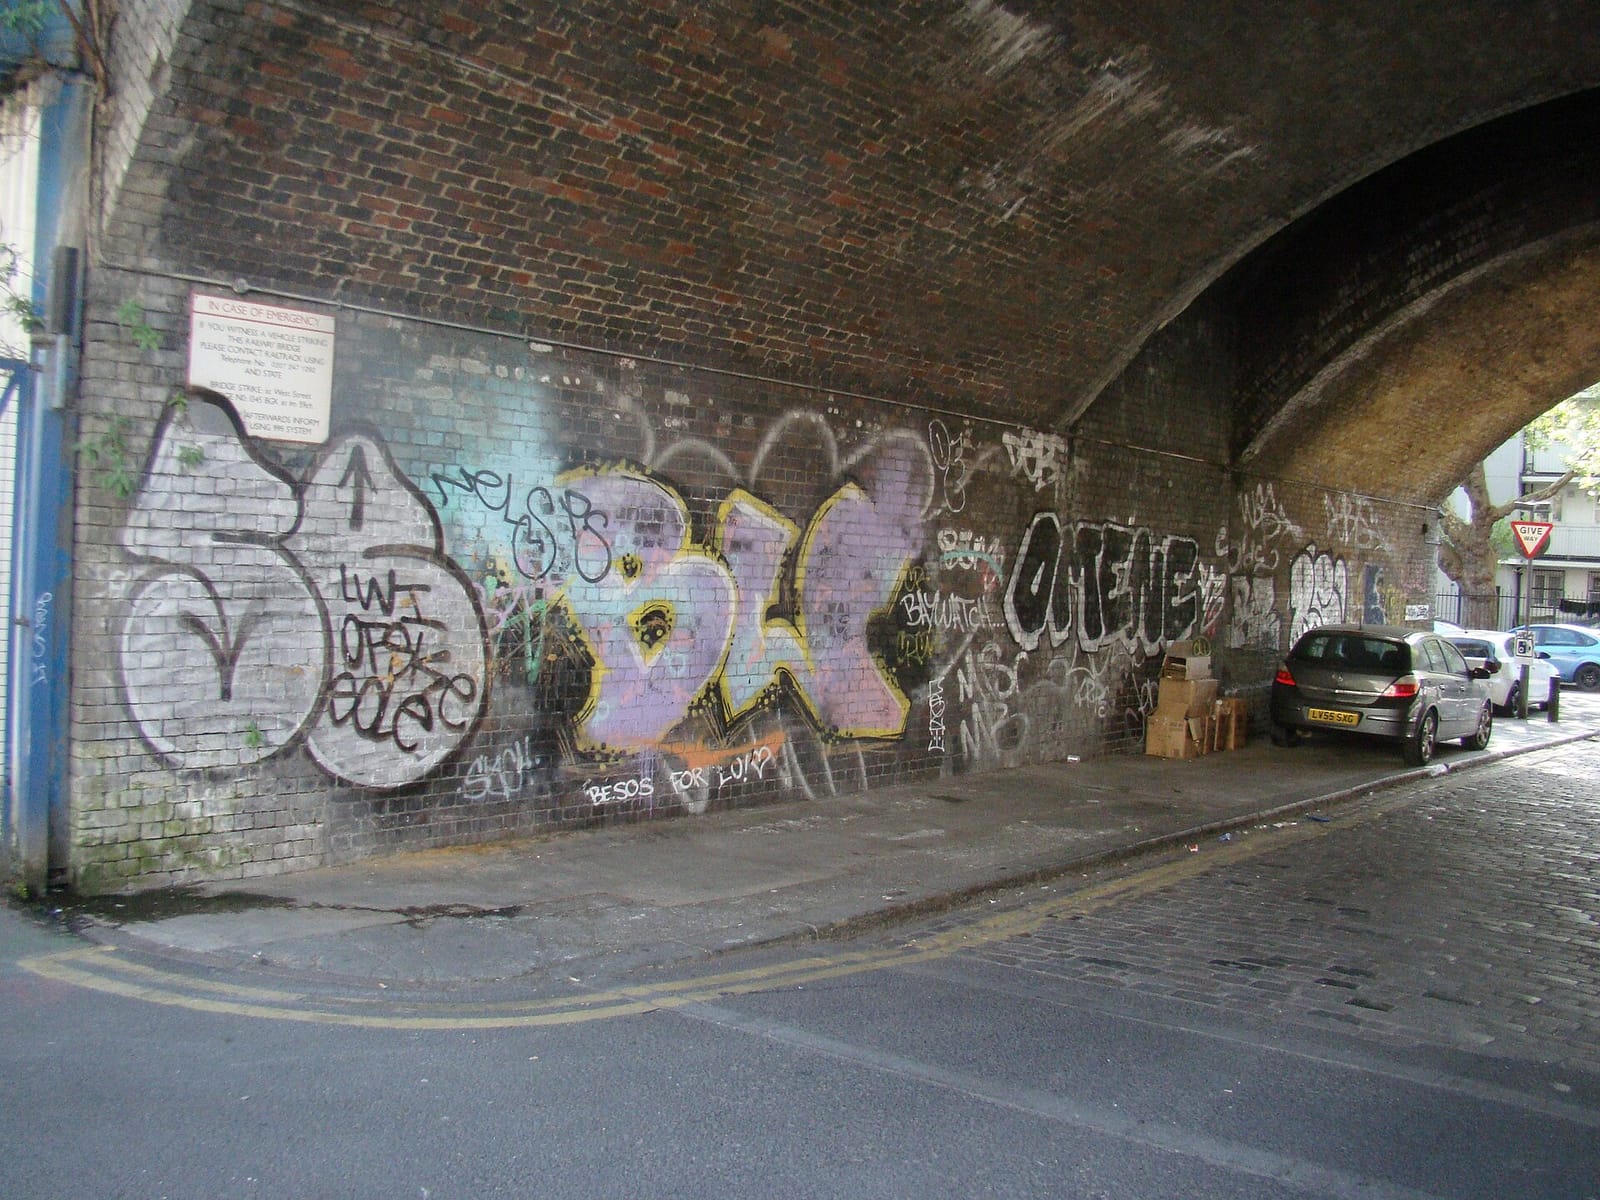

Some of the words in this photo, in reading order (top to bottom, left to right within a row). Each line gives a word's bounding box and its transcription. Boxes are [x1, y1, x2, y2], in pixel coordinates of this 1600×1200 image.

[223, 303, 246, 314] CASE
[267, 311, 319, 326] EMERGENCY
[208, 322, 223, 331] YOU
[227, 325, 257, 336] WITNESS
[269, 332, 295, 341] VEHICLE
[298, 336, 327, 346] STRIKING
[228, 335, 242, 344] THIS
[246, 338, 274, 348] RAILWAY
[277, 343, 300, 352] BRIDGE
[200, 341, 225, 351] PLEASE
[228, 345, 262, 356] CONTACT
[265, 351, 301, 362] RAILTRACK
[304, 356, 324, 365] USING
[221, 354, 250, 365] Telephone
[245, 367, 260, 375] AND
[263, 370, 282, 378] STATE
[210, 381, 235, 390] BRIDGE
[239, 384, 261, 393] STRIKE
[293, 391, 311, 399] Street
[244, 411, 290, 423] AFTERWARDS
[294, 417, 319, 427] INFORM
[250, 421, 271, 430] USING
[287, 425, 311, 435] SYSTEM
[1520, 526, 1543, 535] GIVE
[1336, 713, 1354, 723] SXG
[669, 766, 710, 794] FOR
